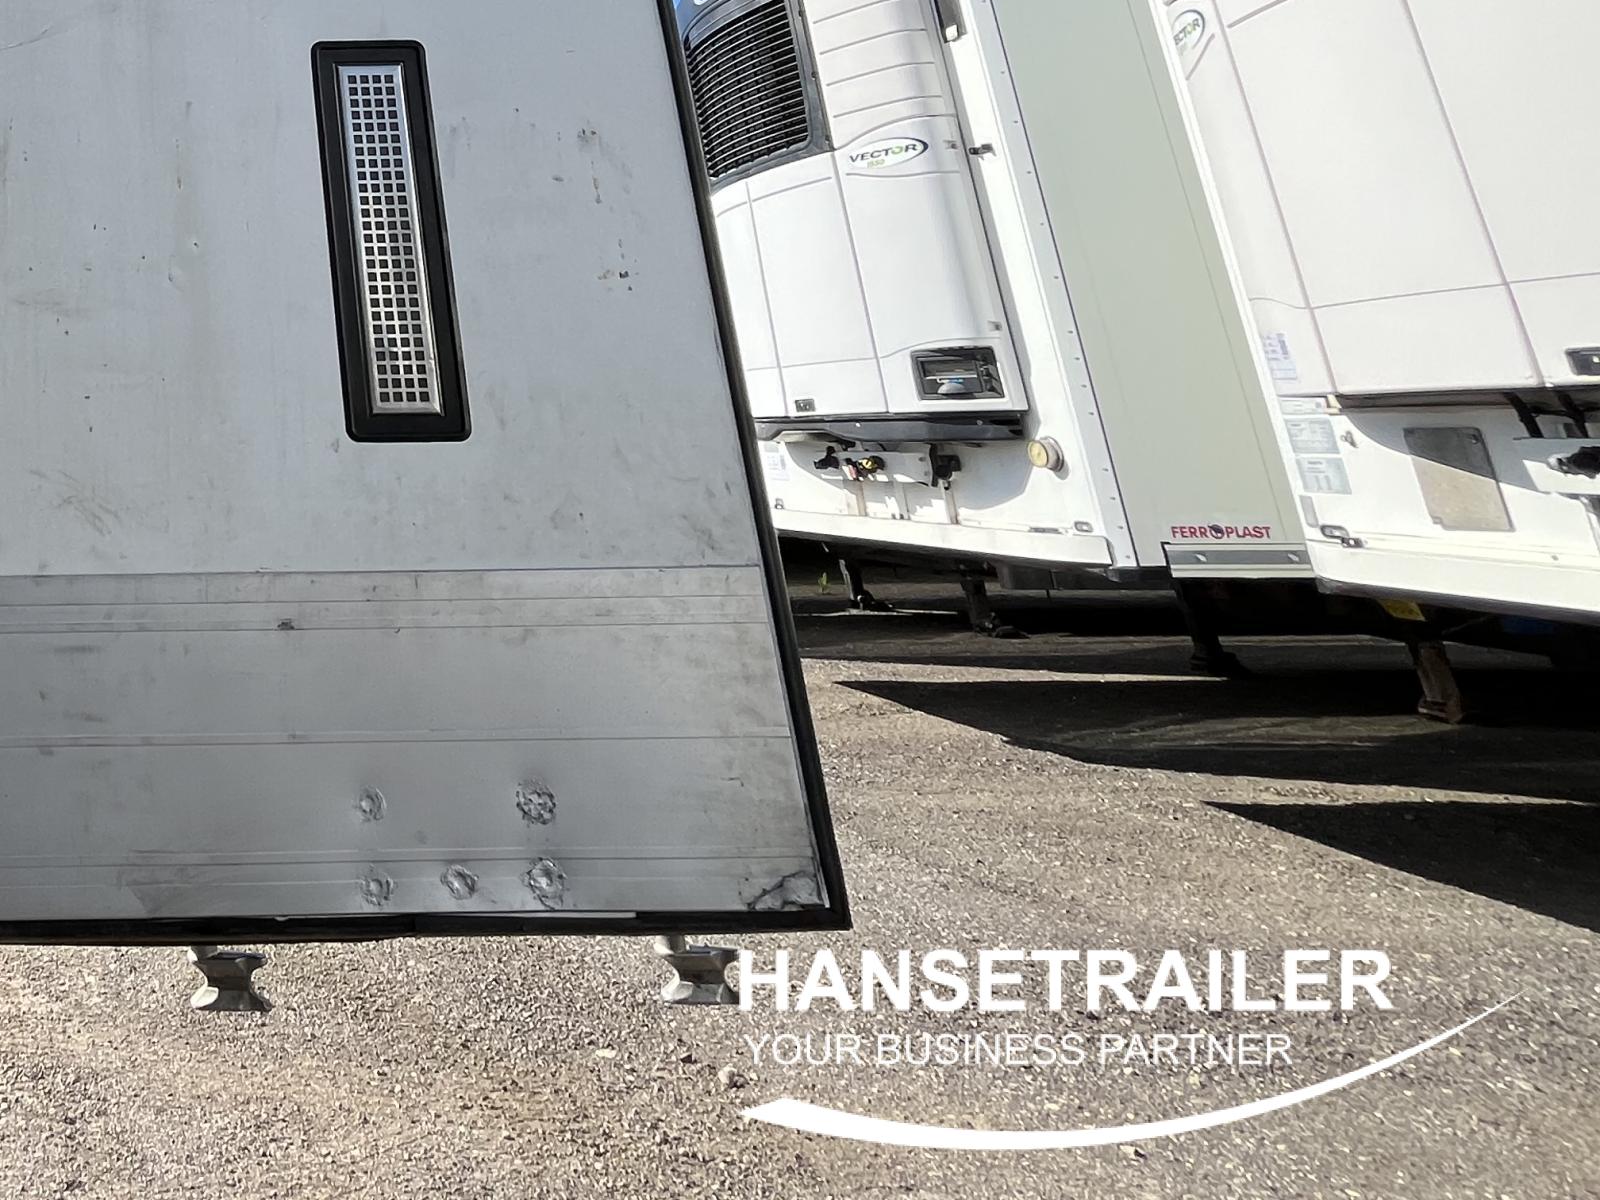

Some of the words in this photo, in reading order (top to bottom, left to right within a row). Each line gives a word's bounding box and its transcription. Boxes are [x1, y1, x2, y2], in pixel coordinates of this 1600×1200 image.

[1172, 17, 1201, 46] ECTOR
[848, 142, 919, 163] VECTOR
[1170, 524, 1271, 540] FERROPLAST
